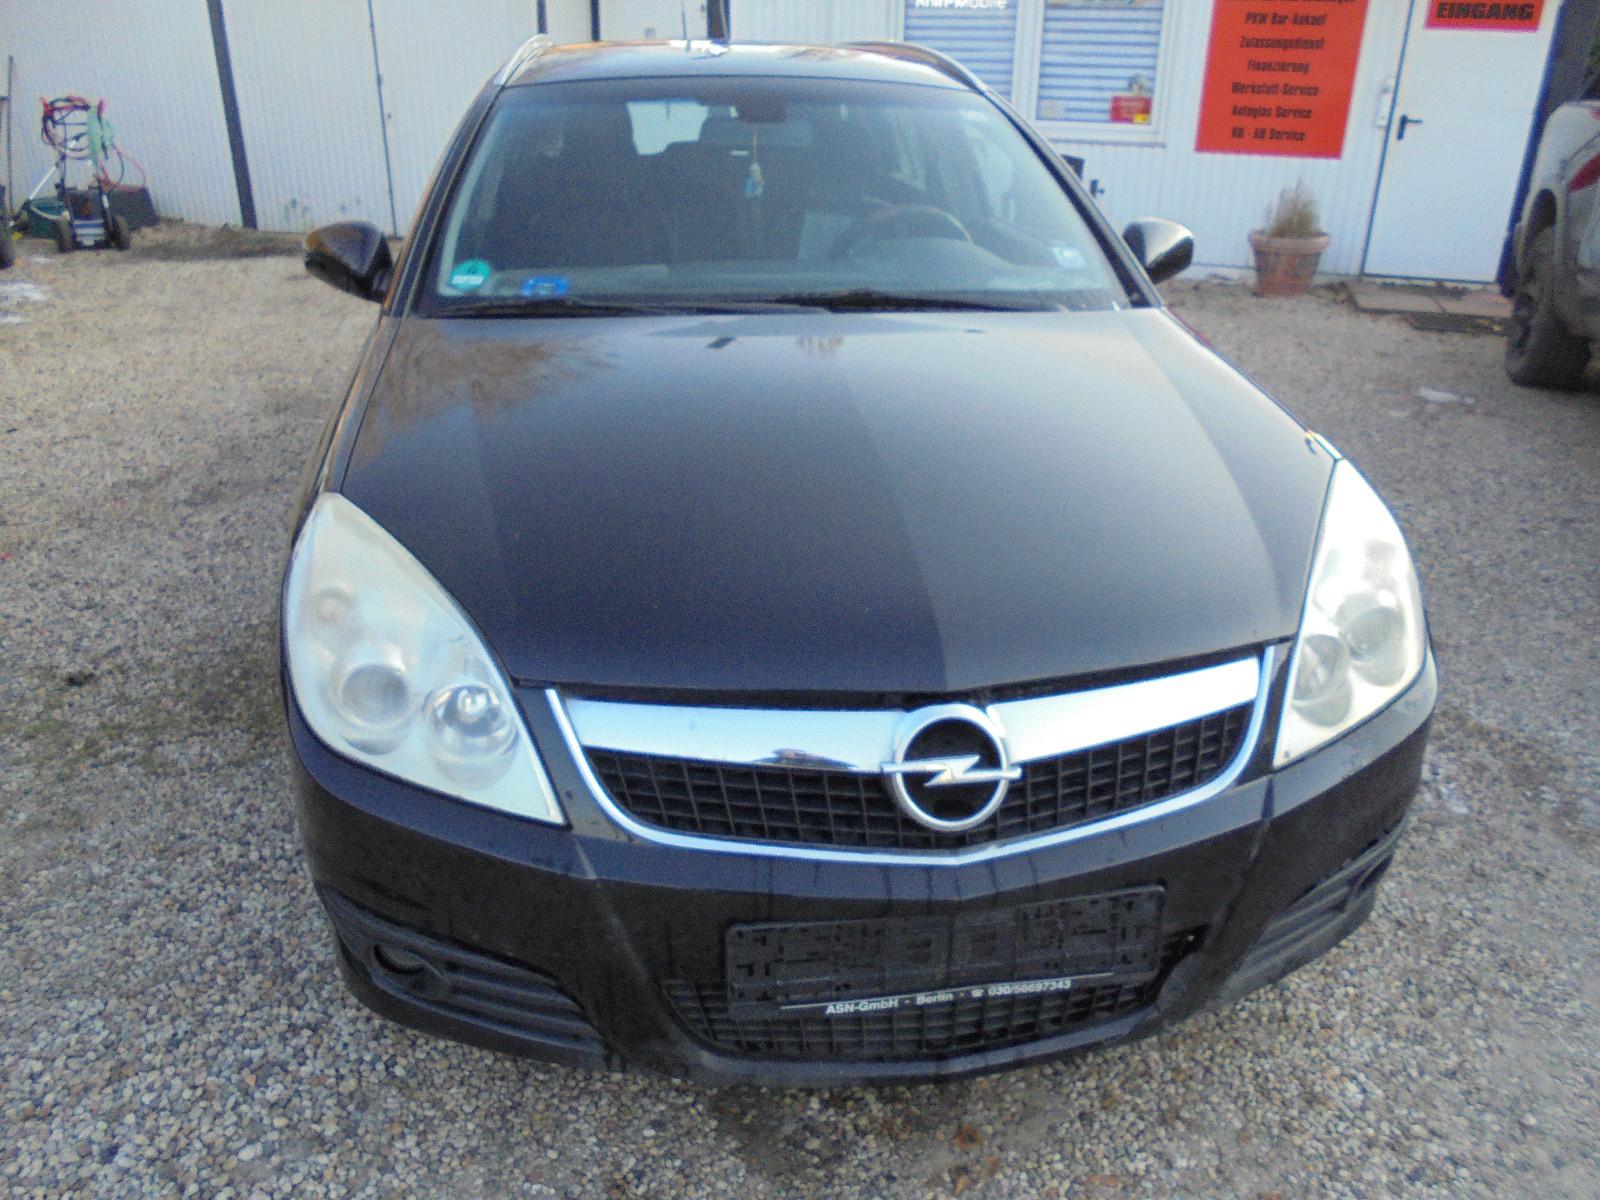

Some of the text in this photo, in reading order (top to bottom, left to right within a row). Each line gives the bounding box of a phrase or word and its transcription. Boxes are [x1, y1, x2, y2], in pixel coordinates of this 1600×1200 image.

[1244, 12, 1267, 25] PKW
[1271, 12, 1288, 25] Bar
[1437, 2, 1535, 20] EINGANG
[1240, 35, 1325, 51] Zulassungsdienst
[1247, 60, 1310, 75] Finanzierung
[1232, 105, 1312, 119] Autoglas Service
[1269, 128, 1306, 141] Service
[825, 998, 898, 1015] ASN-GmbH
[916, 992, 953, 1006] Berlin
